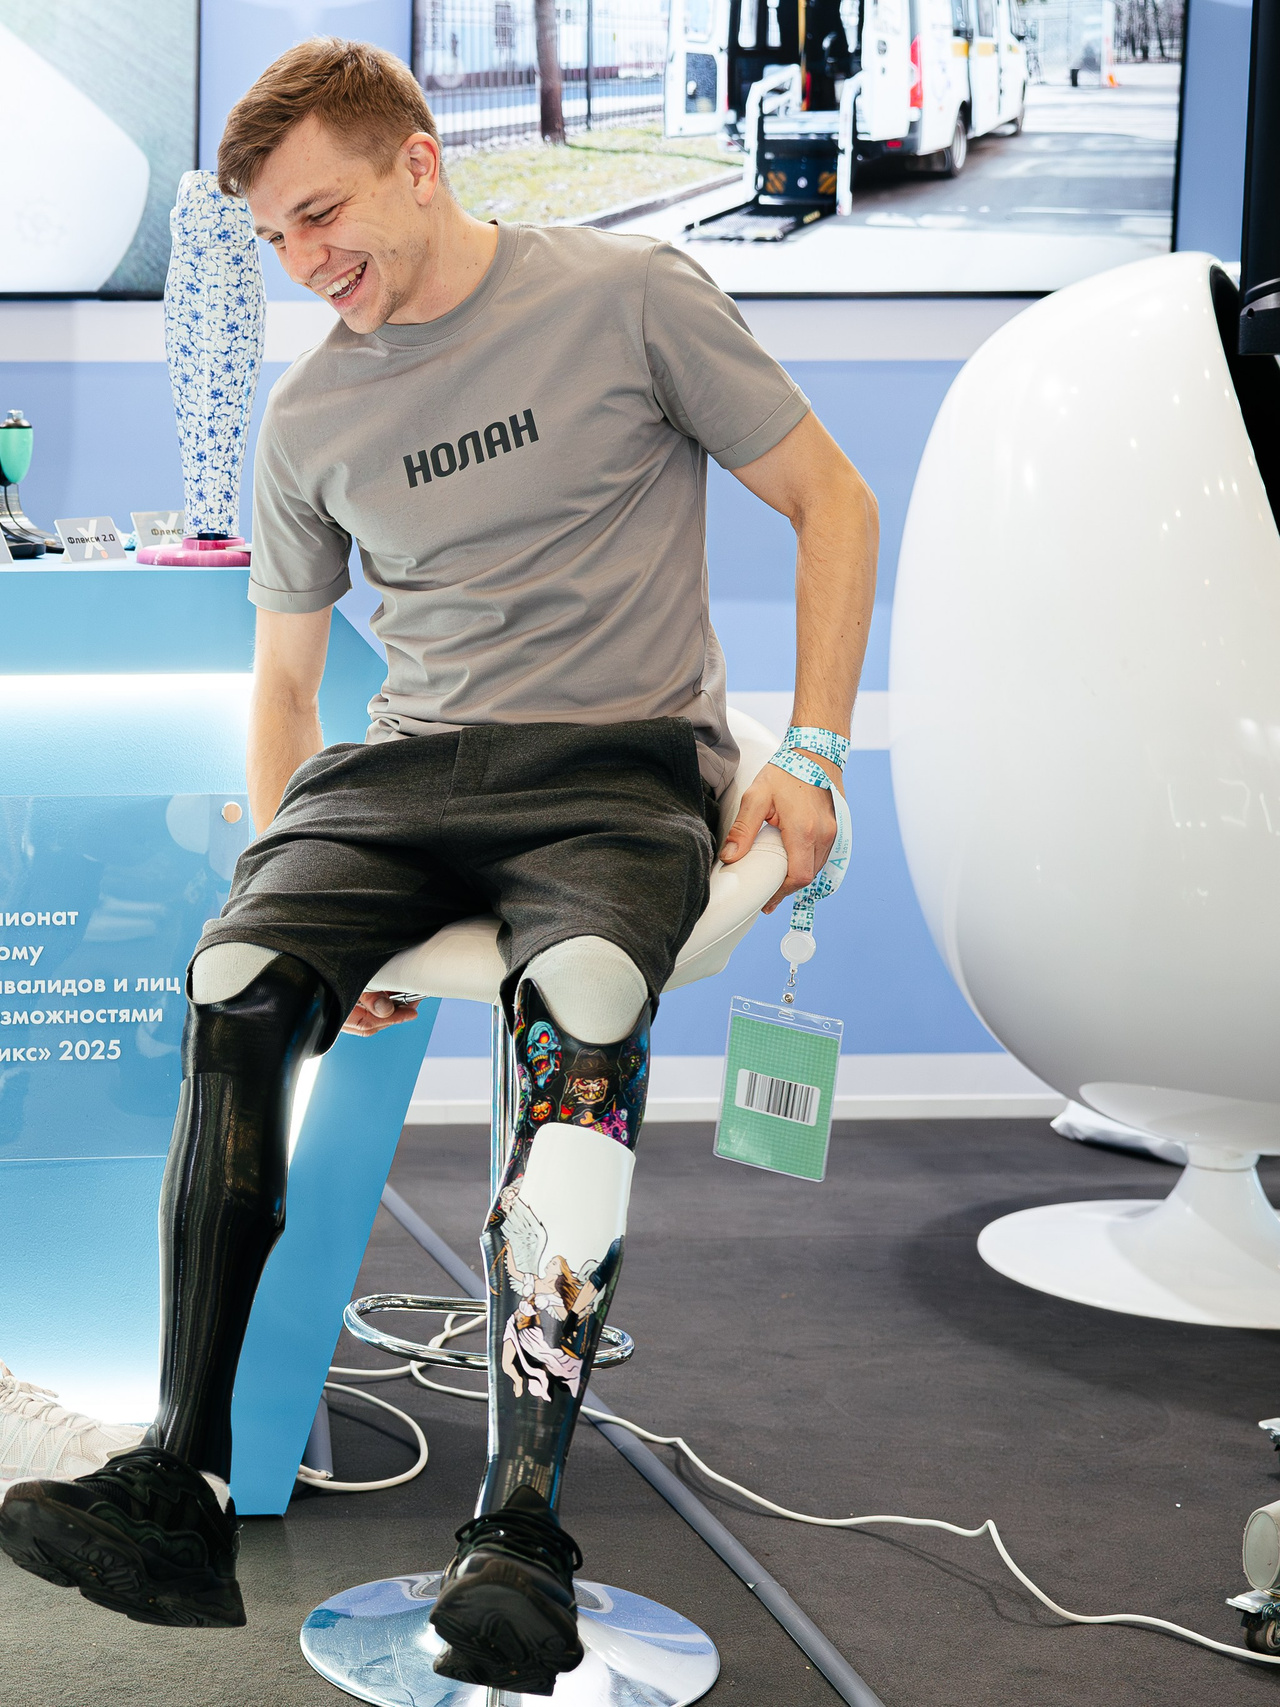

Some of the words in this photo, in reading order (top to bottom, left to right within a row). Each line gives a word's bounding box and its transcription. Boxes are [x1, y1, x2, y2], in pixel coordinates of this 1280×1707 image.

[402, 407, 540, 489] НОЛАН
[67, 535, 101, 545] Флекси
[102, 533, 116, 543] 2.0
[113, 978, 129, 992] и
[135, 977, 182, 995] лиц
[58, 1039, 122, 1062] 2025
